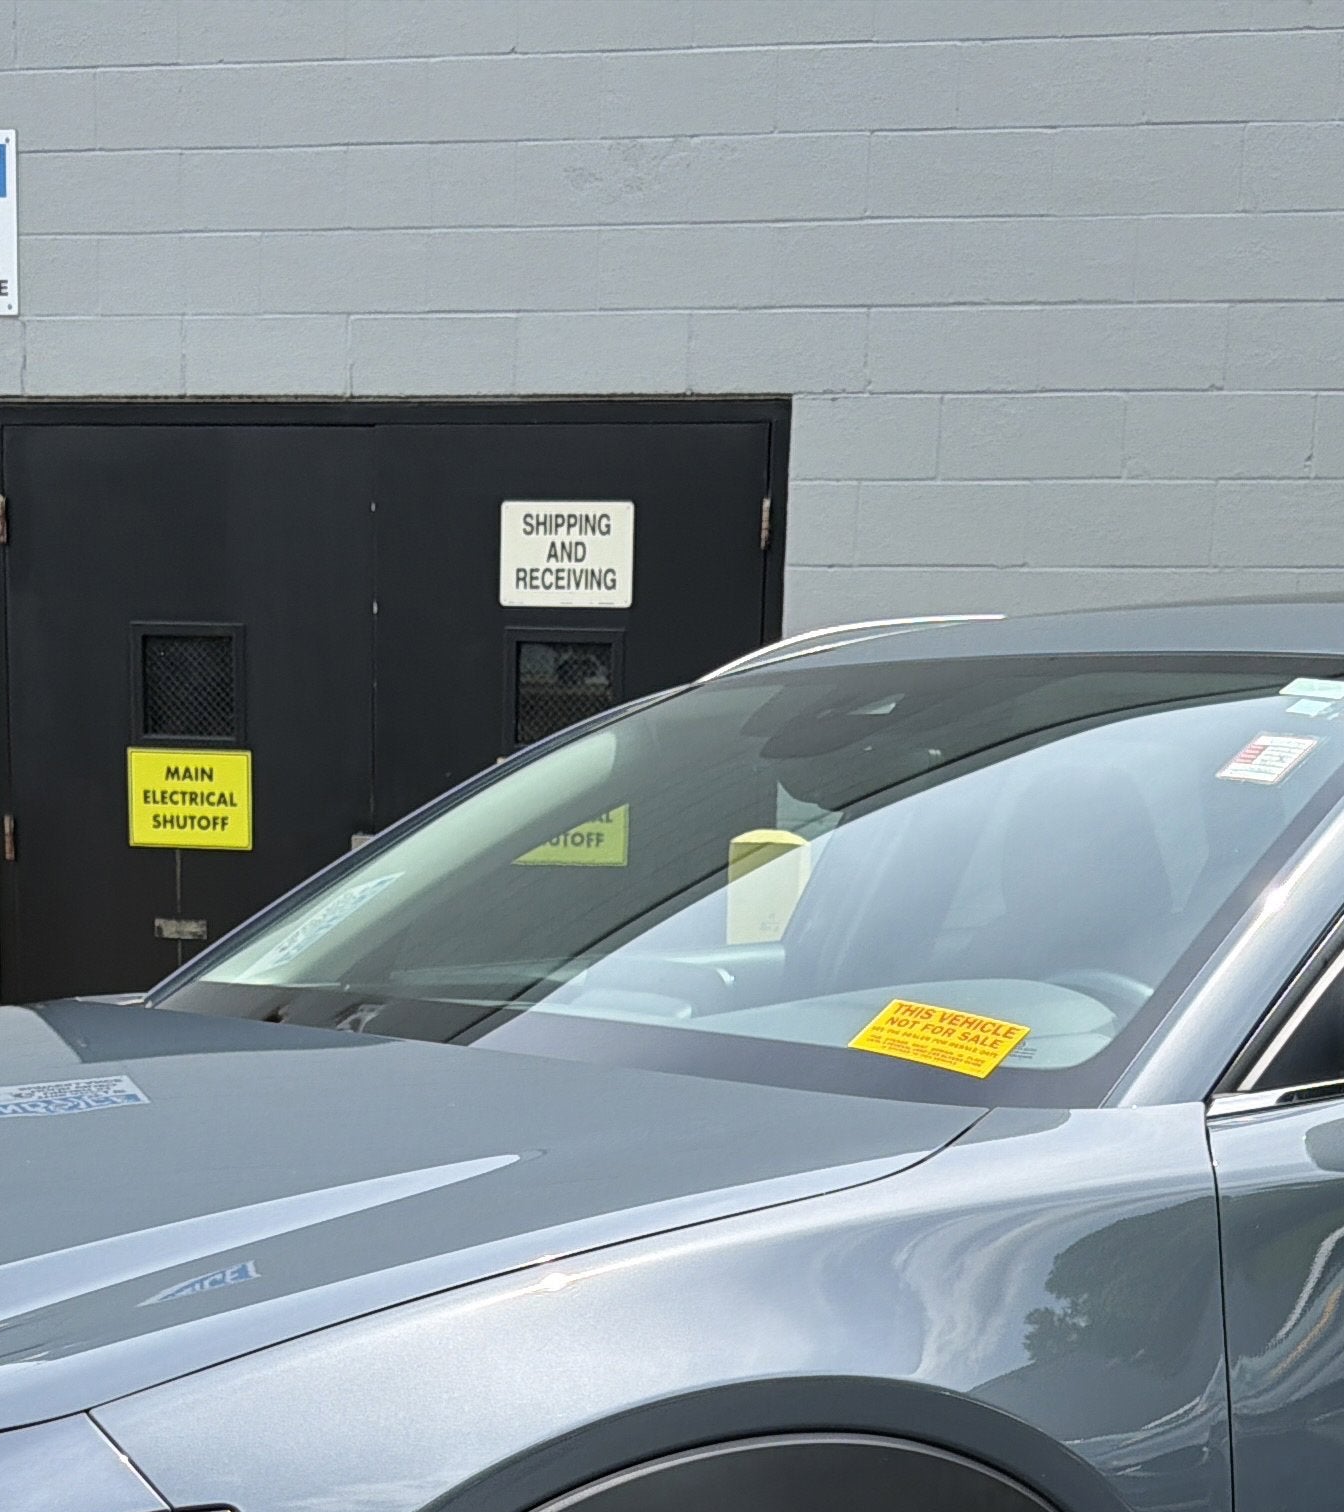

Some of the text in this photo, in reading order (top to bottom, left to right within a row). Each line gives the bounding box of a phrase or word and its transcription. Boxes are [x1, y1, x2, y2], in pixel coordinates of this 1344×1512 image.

[522, 513, 611, 536] SHIPPING
[546, 541, 586, 563] AND
[515, 568, 617, 590] RECEIVING
[165, 766, 214, 782] MAIN
[143, 790, 238, 807] ELECTRICAL
[152, 814, 230, 831] SHUTOFF
[893, 1002, 1020, 1040] THIS VEHICLE
[886, 1016, 920, 1030] NOT
[921, 1023, 956, 1038] FOR
[957, 1031, 1004, 1050] SALE
